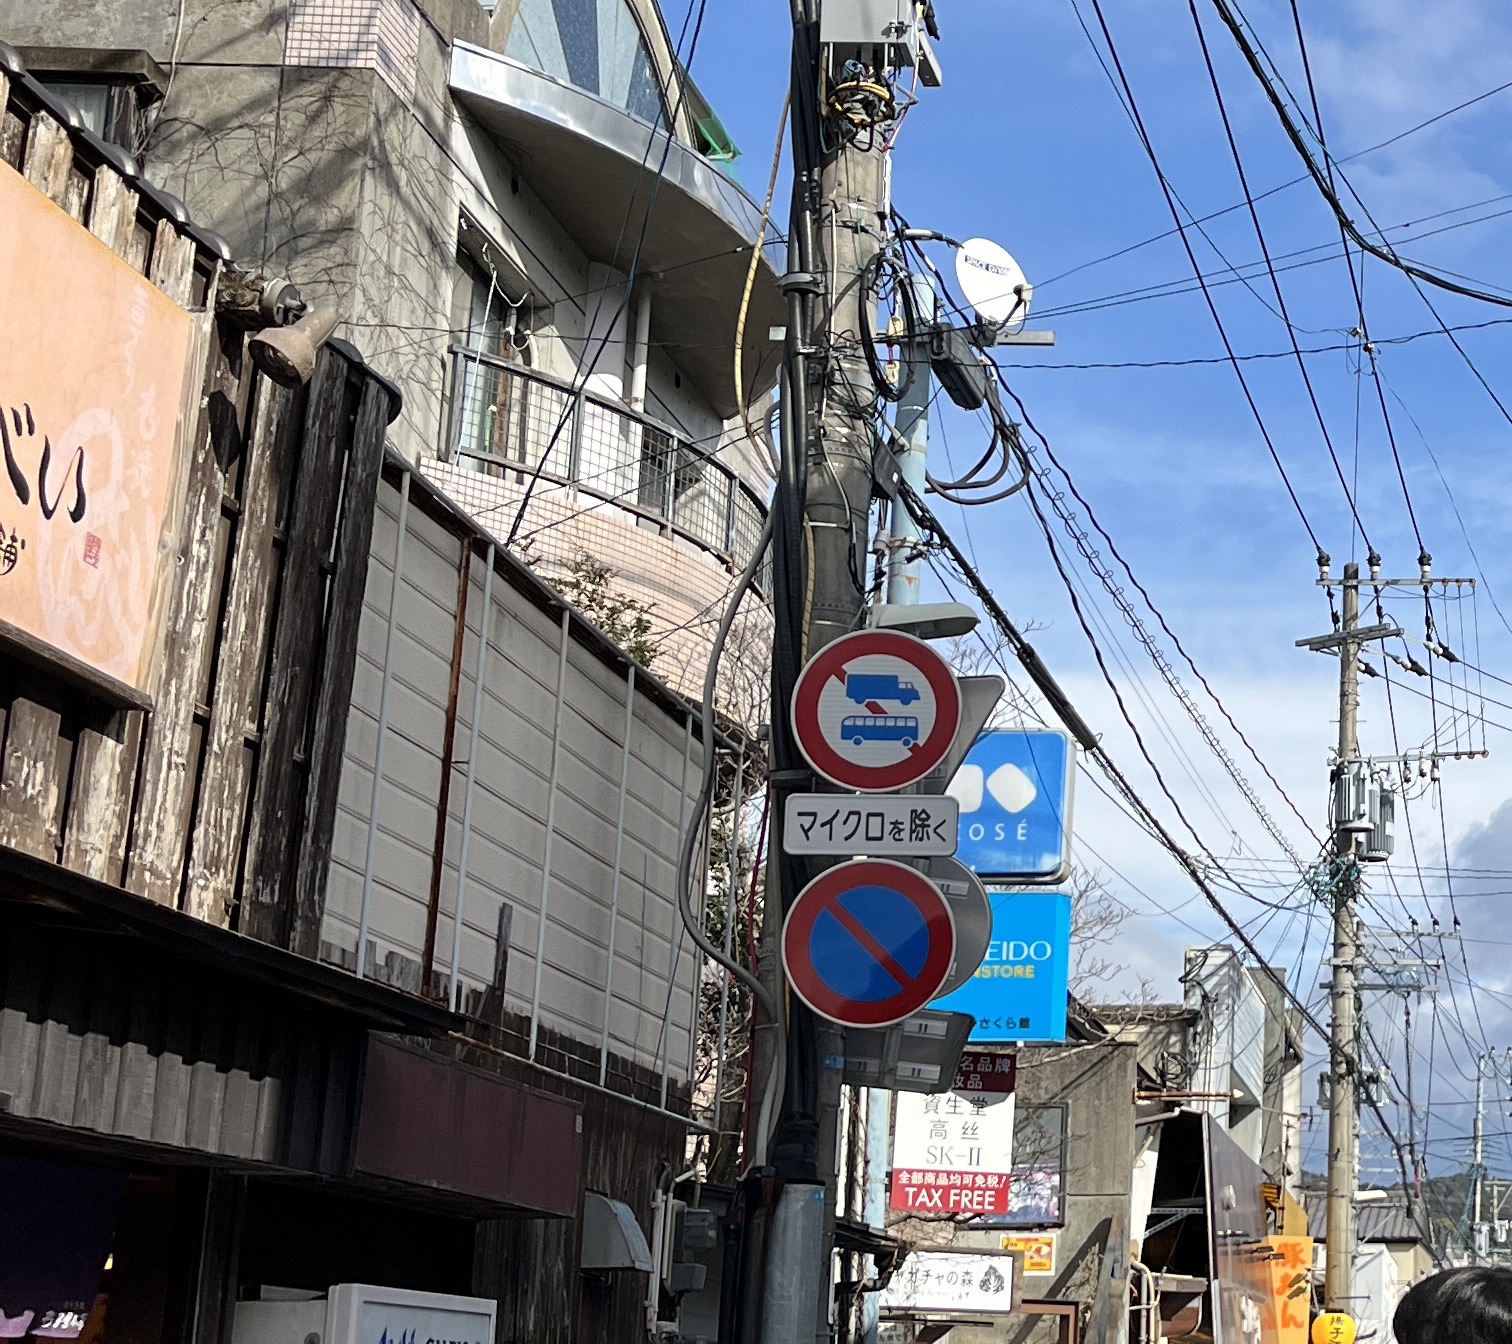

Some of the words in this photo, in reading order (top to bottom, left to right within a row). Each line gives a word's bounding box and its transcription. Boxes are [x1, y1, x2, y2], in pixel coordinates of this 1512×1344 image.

[797, 808, 947, 842] マイクロを除く
[957, 819, 1028, 841] OSÉ
[926, 1145, 983, 1167] SK-II
[905, 1187, 943, 1207] TAX
[949, 1189, 997, 1210] FREE
